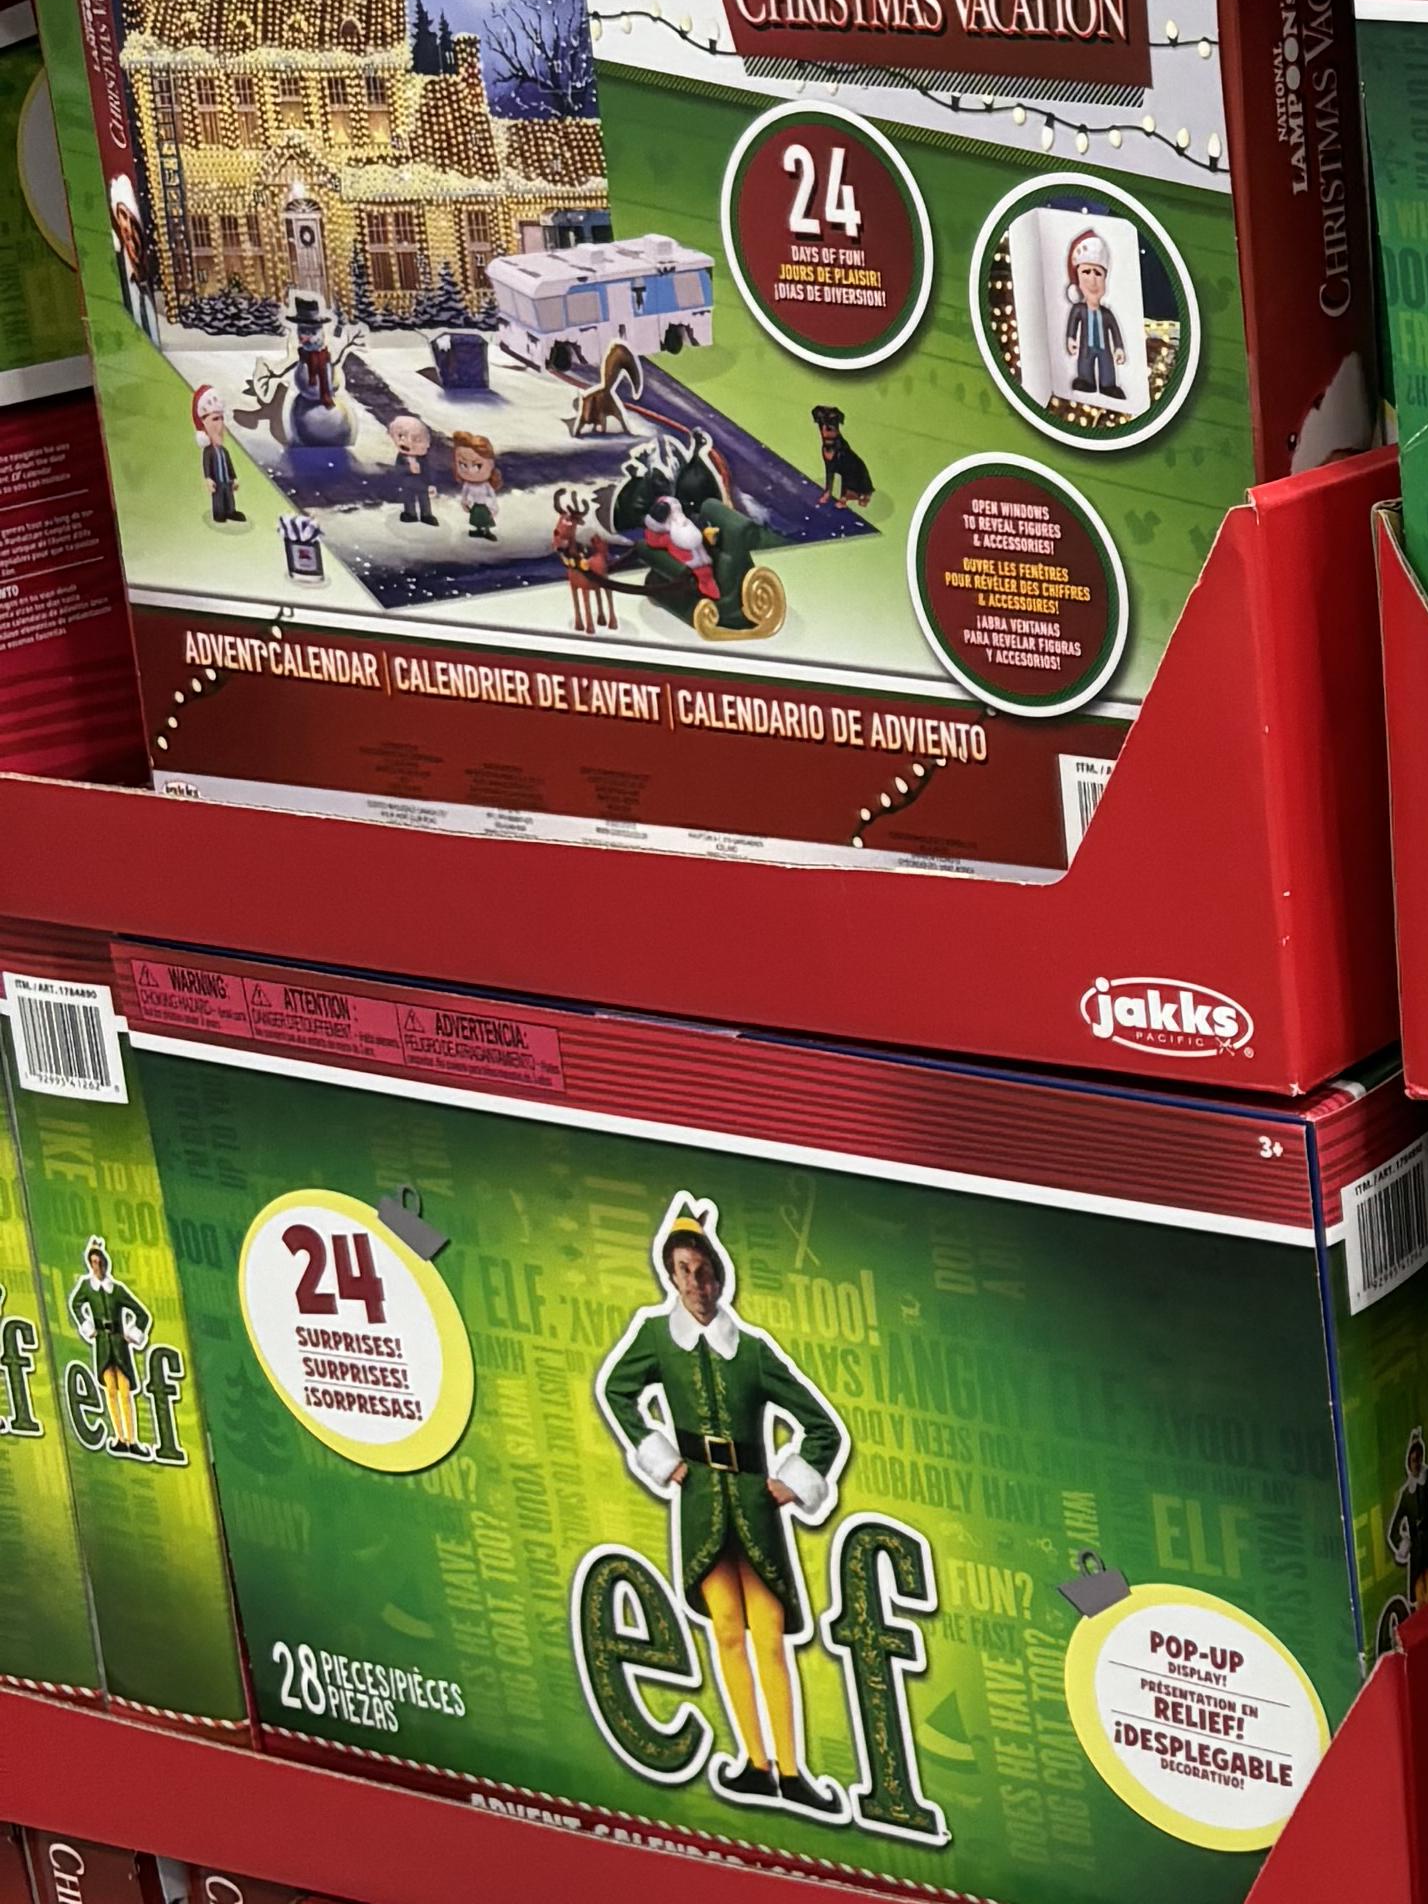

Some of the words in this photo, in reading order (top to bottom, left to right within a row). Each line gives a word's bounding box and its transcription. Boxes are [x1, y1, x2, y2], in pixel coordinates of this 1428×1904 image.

[782, 143, 861, 237] 24
[791, 245, 820, 262] DAYS
[822, 248, 837, 264] OF
[839, 249, 866, 267] FUN!
[779, 263, 810, 280] JOURS
[814, 266, 831, 282] DE
[834, 267, 881, 287] PLAISIR!
[807, 286, 824, 302] DE
[972, 499, 997, 514] OPEN
[1000, 502, 1049, 520] WINDOWS
[963, 515, 976, 529] TO
[978, 517, 1016, 533] REVEAL
[1018, 521, 1061, 538] FIGURES
[984, 536, 1054, 555] ACCESSORIES!
[185, 631, 261, 670] ADVENT
[269, 644, 380, 689] CALENDAR
[395, 658, 532, 707] CALENDRIER
[540, 675, 569, 709] DE
[573, 678, 661, 722] L'AVENT
[677, 690, 825, 743] CALENDARIO
[833, 710, 864, 745] DE
[871, 716, 987, 763] ADVIENTO
[1092, 977, 1238, 1038] jakks
[281, 1223, 387, 1324] 24
[295, 1326, 403, 1359] SURPRISES!
[302, 1357, 409, 1390] SURPRISES!
[304, 1387, 423, 1421] ¡SORPRESAS!
[273, 1641, 326, 1717] 28
[321, 1651, 466, 1718] PIECES/PIÈCES
[328, 1684, 399, 1733] PIEZAS
